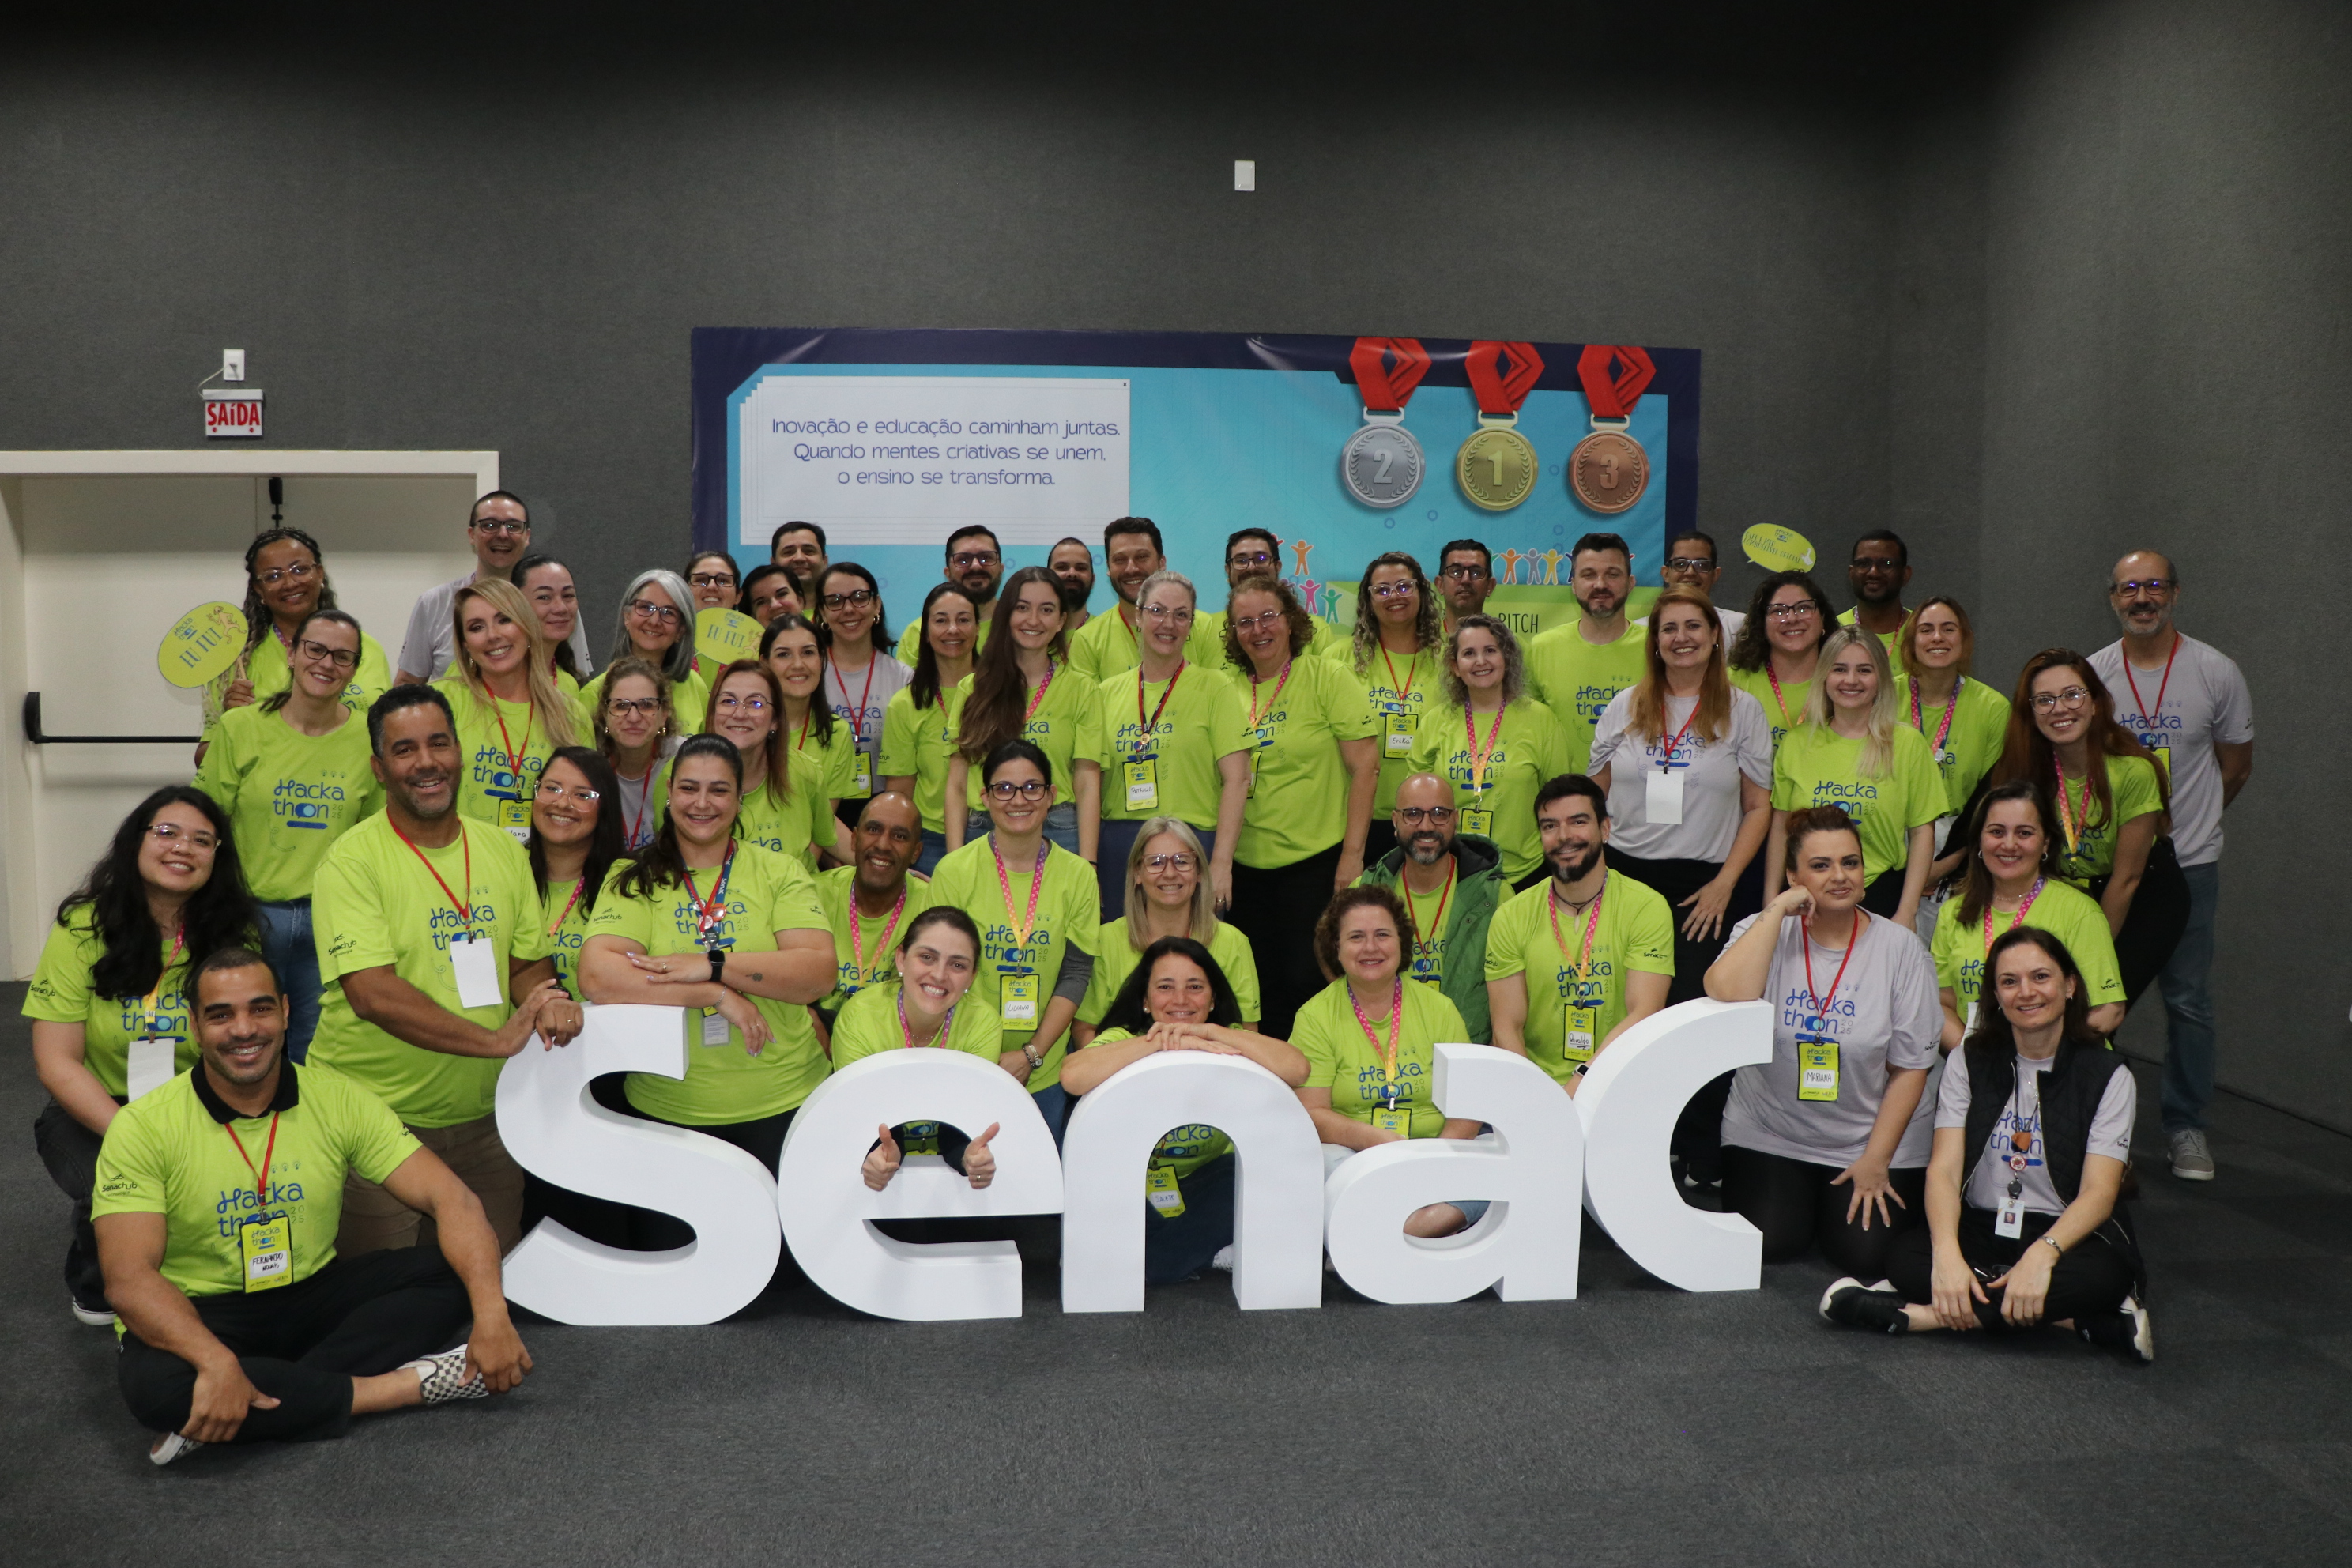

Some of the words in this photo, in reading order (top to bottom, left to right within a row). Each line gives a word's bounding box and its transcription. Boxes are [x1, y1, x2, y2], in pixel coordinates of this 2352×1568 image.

[771, 417, 850, 438] Inovação
[857, 421, 868, 434] e
[875, 417, 962, 438] educação
[968, 420, 1059, 435] caminham
[1062, 420, 1121, 439] juntas.
[793, 443, 865, 462] Quando
[872, 444, 940, 460] mentes
[947, 444, 1020, 460] criativas
[1027, 447, 1049, 460] se
[1374, 448, 1393, 484] 2
[1487, 450, 1502, 487] 1
[1600, 454, 1619, 489] 3
[838, 472, 850, 484] o
[857, 469, 914, 484] ensino
[921, 471, 943, 485] se
[950, 469, 1056, 485] transforma.
[707, 624, 722, 640] EU
[724, 631, 745, 648] FUI
[179, 646, 201, 668] EU
[195, 628, 222, 652] FUI
[1368, 686, 1423, 703] Hacka
[1576, 685, 1624, 701] Hack
[1021, 718, 1050, 734] cka
[1257, 710, 1287, 726] cka
[2120, 712, 2182, 729] Hacka
[1117, 722, 1173, 738] Haka
[1650, 732, 1706, 748] acka
[475, 744, 542, 772] Hacka
[473, 765, 526, 790] thon
[273, 778, 345, 801] Hacka
[1813, 780, 1878, 800] Hacka
[273, 798, 330, 819] thon
[675, 918, 735, 936] thn
[986, 923, 1050, 945] Haka
[1413, 937, 1446, 956] acka
[1785, 988, 1856, 1017] Hacka
[1784, 1008, 1839, 1034] thon
[1840, 1027, 1853, 1035] 25
[1807, 1072, 1832, 1083] MARIANA
[1996, 1110, 2041, 1133] Hack
[1165, 1124, 1214, 1143] acka
[1990, 1131, 2041, 1155] thn
[290, 1205, 305, 1215] 20
[291, 1215, 305, 1224] 25
[251, 1227, 281, 1238] Hacka
[253, 1252, 284, 1266] FERNANDO
